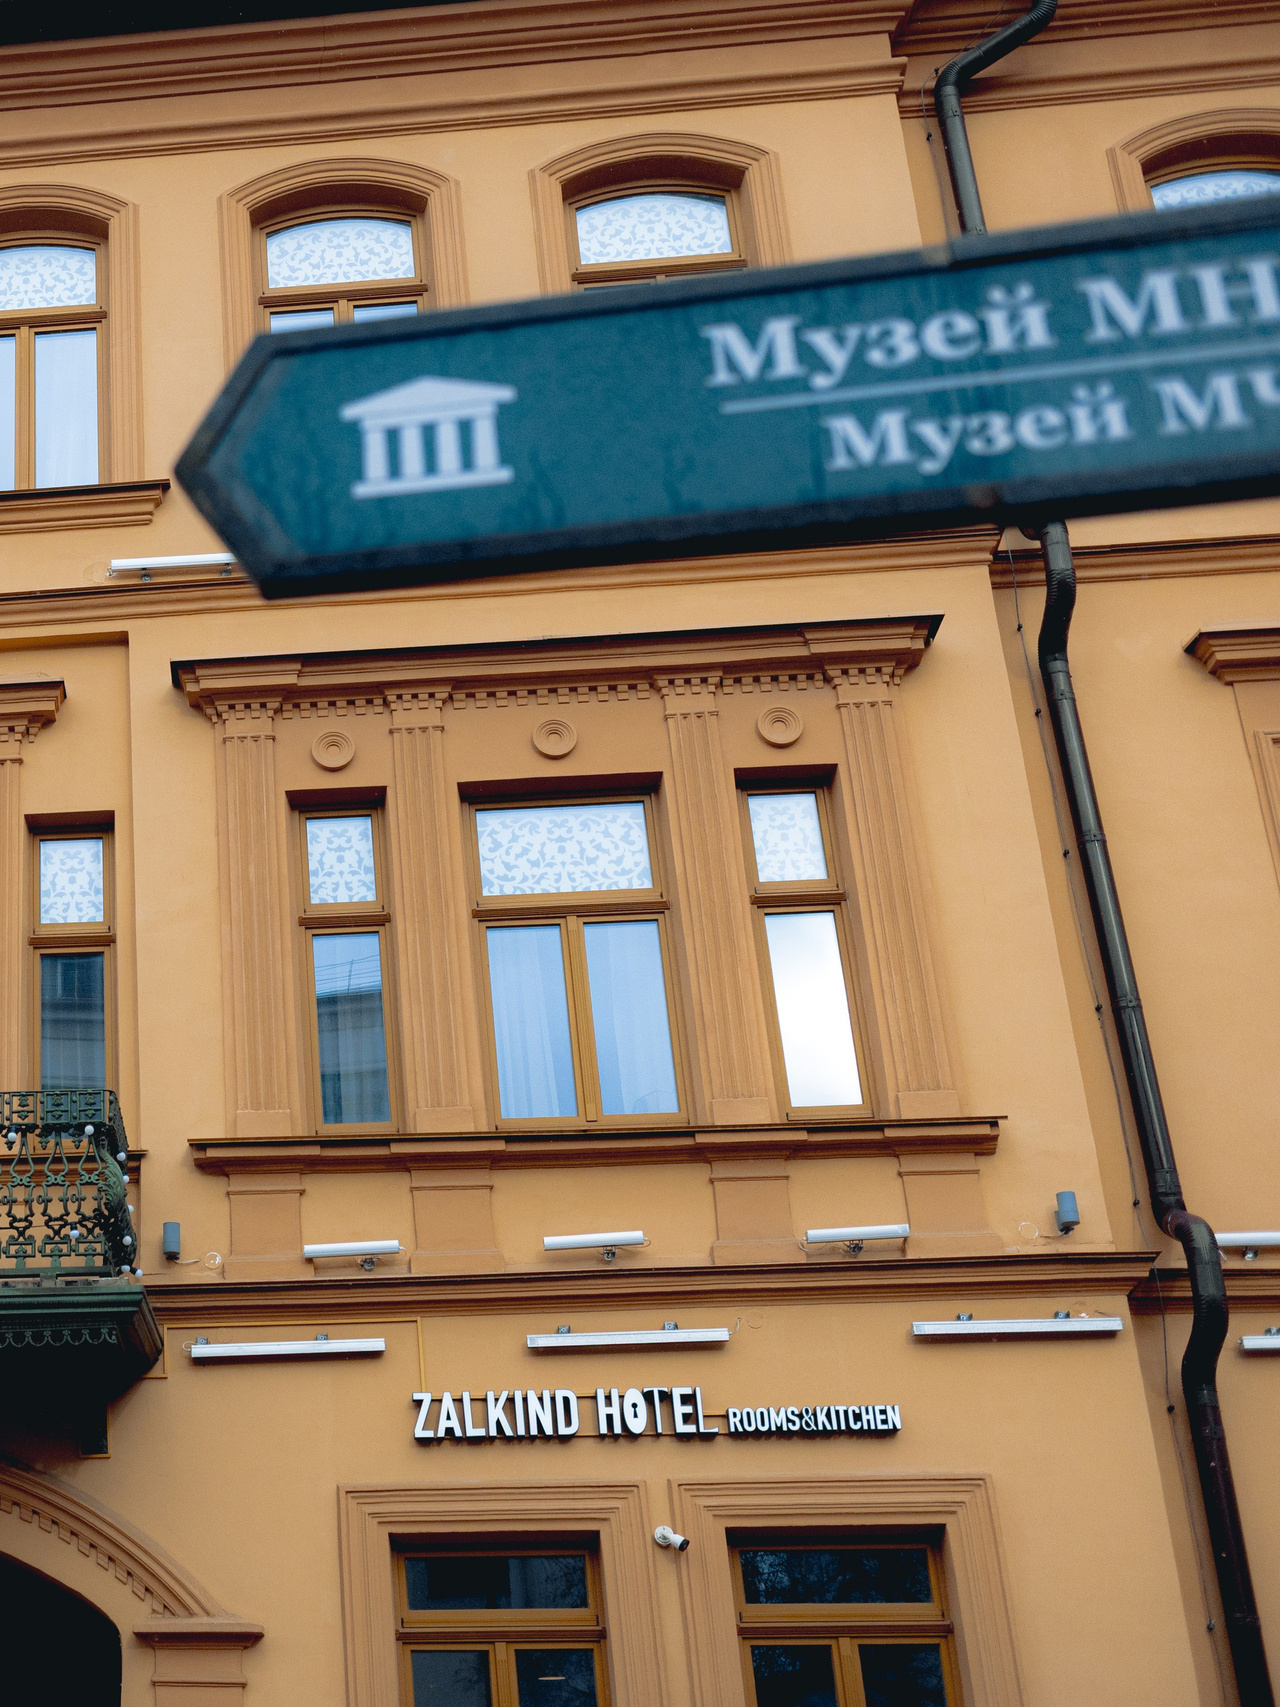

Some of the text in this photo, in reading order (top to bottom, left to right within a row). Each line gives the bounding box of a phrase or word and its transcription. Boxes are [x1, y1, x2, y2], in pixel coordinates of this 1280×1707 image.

[701, 282, 1058, 391] Музей
[822, 379, 1135, 477] Музей
[412, 1386, 903, 1439] ZALKIND HOTEL ROOMS&KITCHEN
